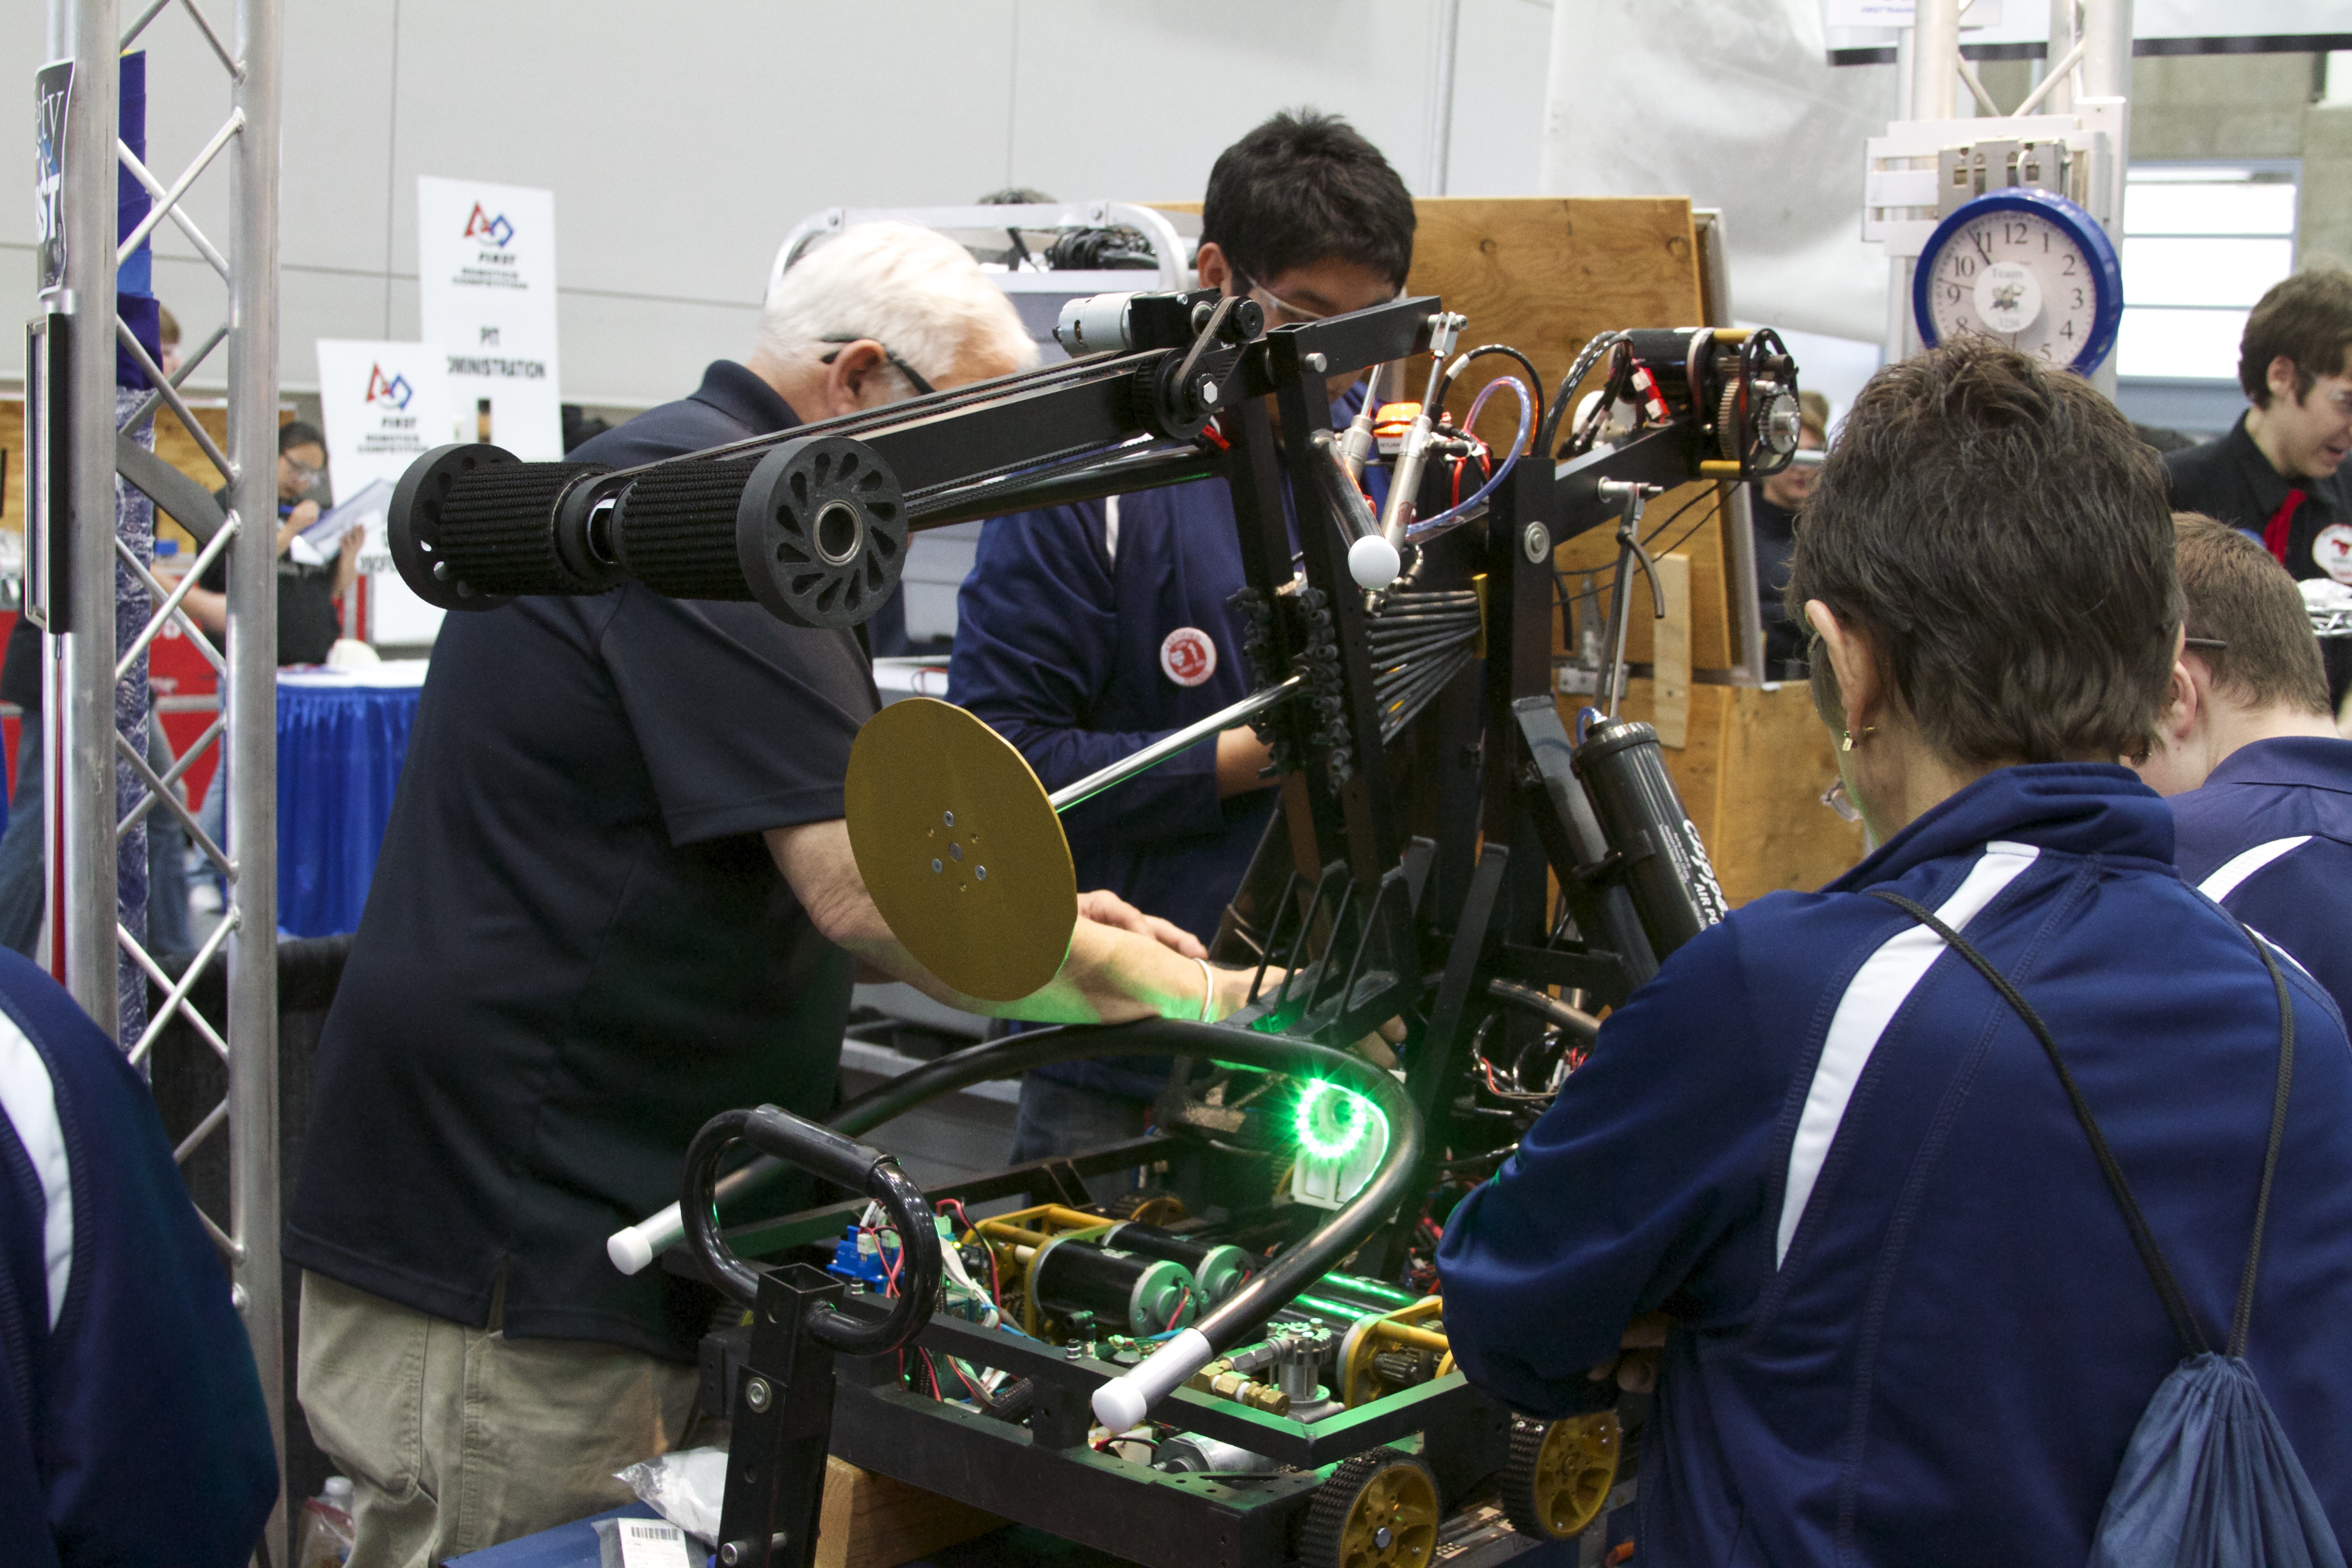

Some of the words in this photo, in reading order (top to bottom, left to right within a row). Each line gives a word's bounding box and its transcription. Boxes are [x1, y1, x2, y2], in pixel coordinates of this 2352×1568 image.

[1977, 231, 1993, 253] 11
[2005, 223, 2028, 245] 12
[2043, 232, 2050, 253] 1
[1954, 255, 1975, 277] 10
[2062, 255, 2076, 276] 2
[1948, 285, 1960, 306] 9
[2071, 288, 2084, 310] 3
[2060, 319, 2074, 341] 4
[1683, 819, 1729, 919] Clippe
[1694, 882, 1712, 906] AIR
[1704, 908, 1720, 925] PO
